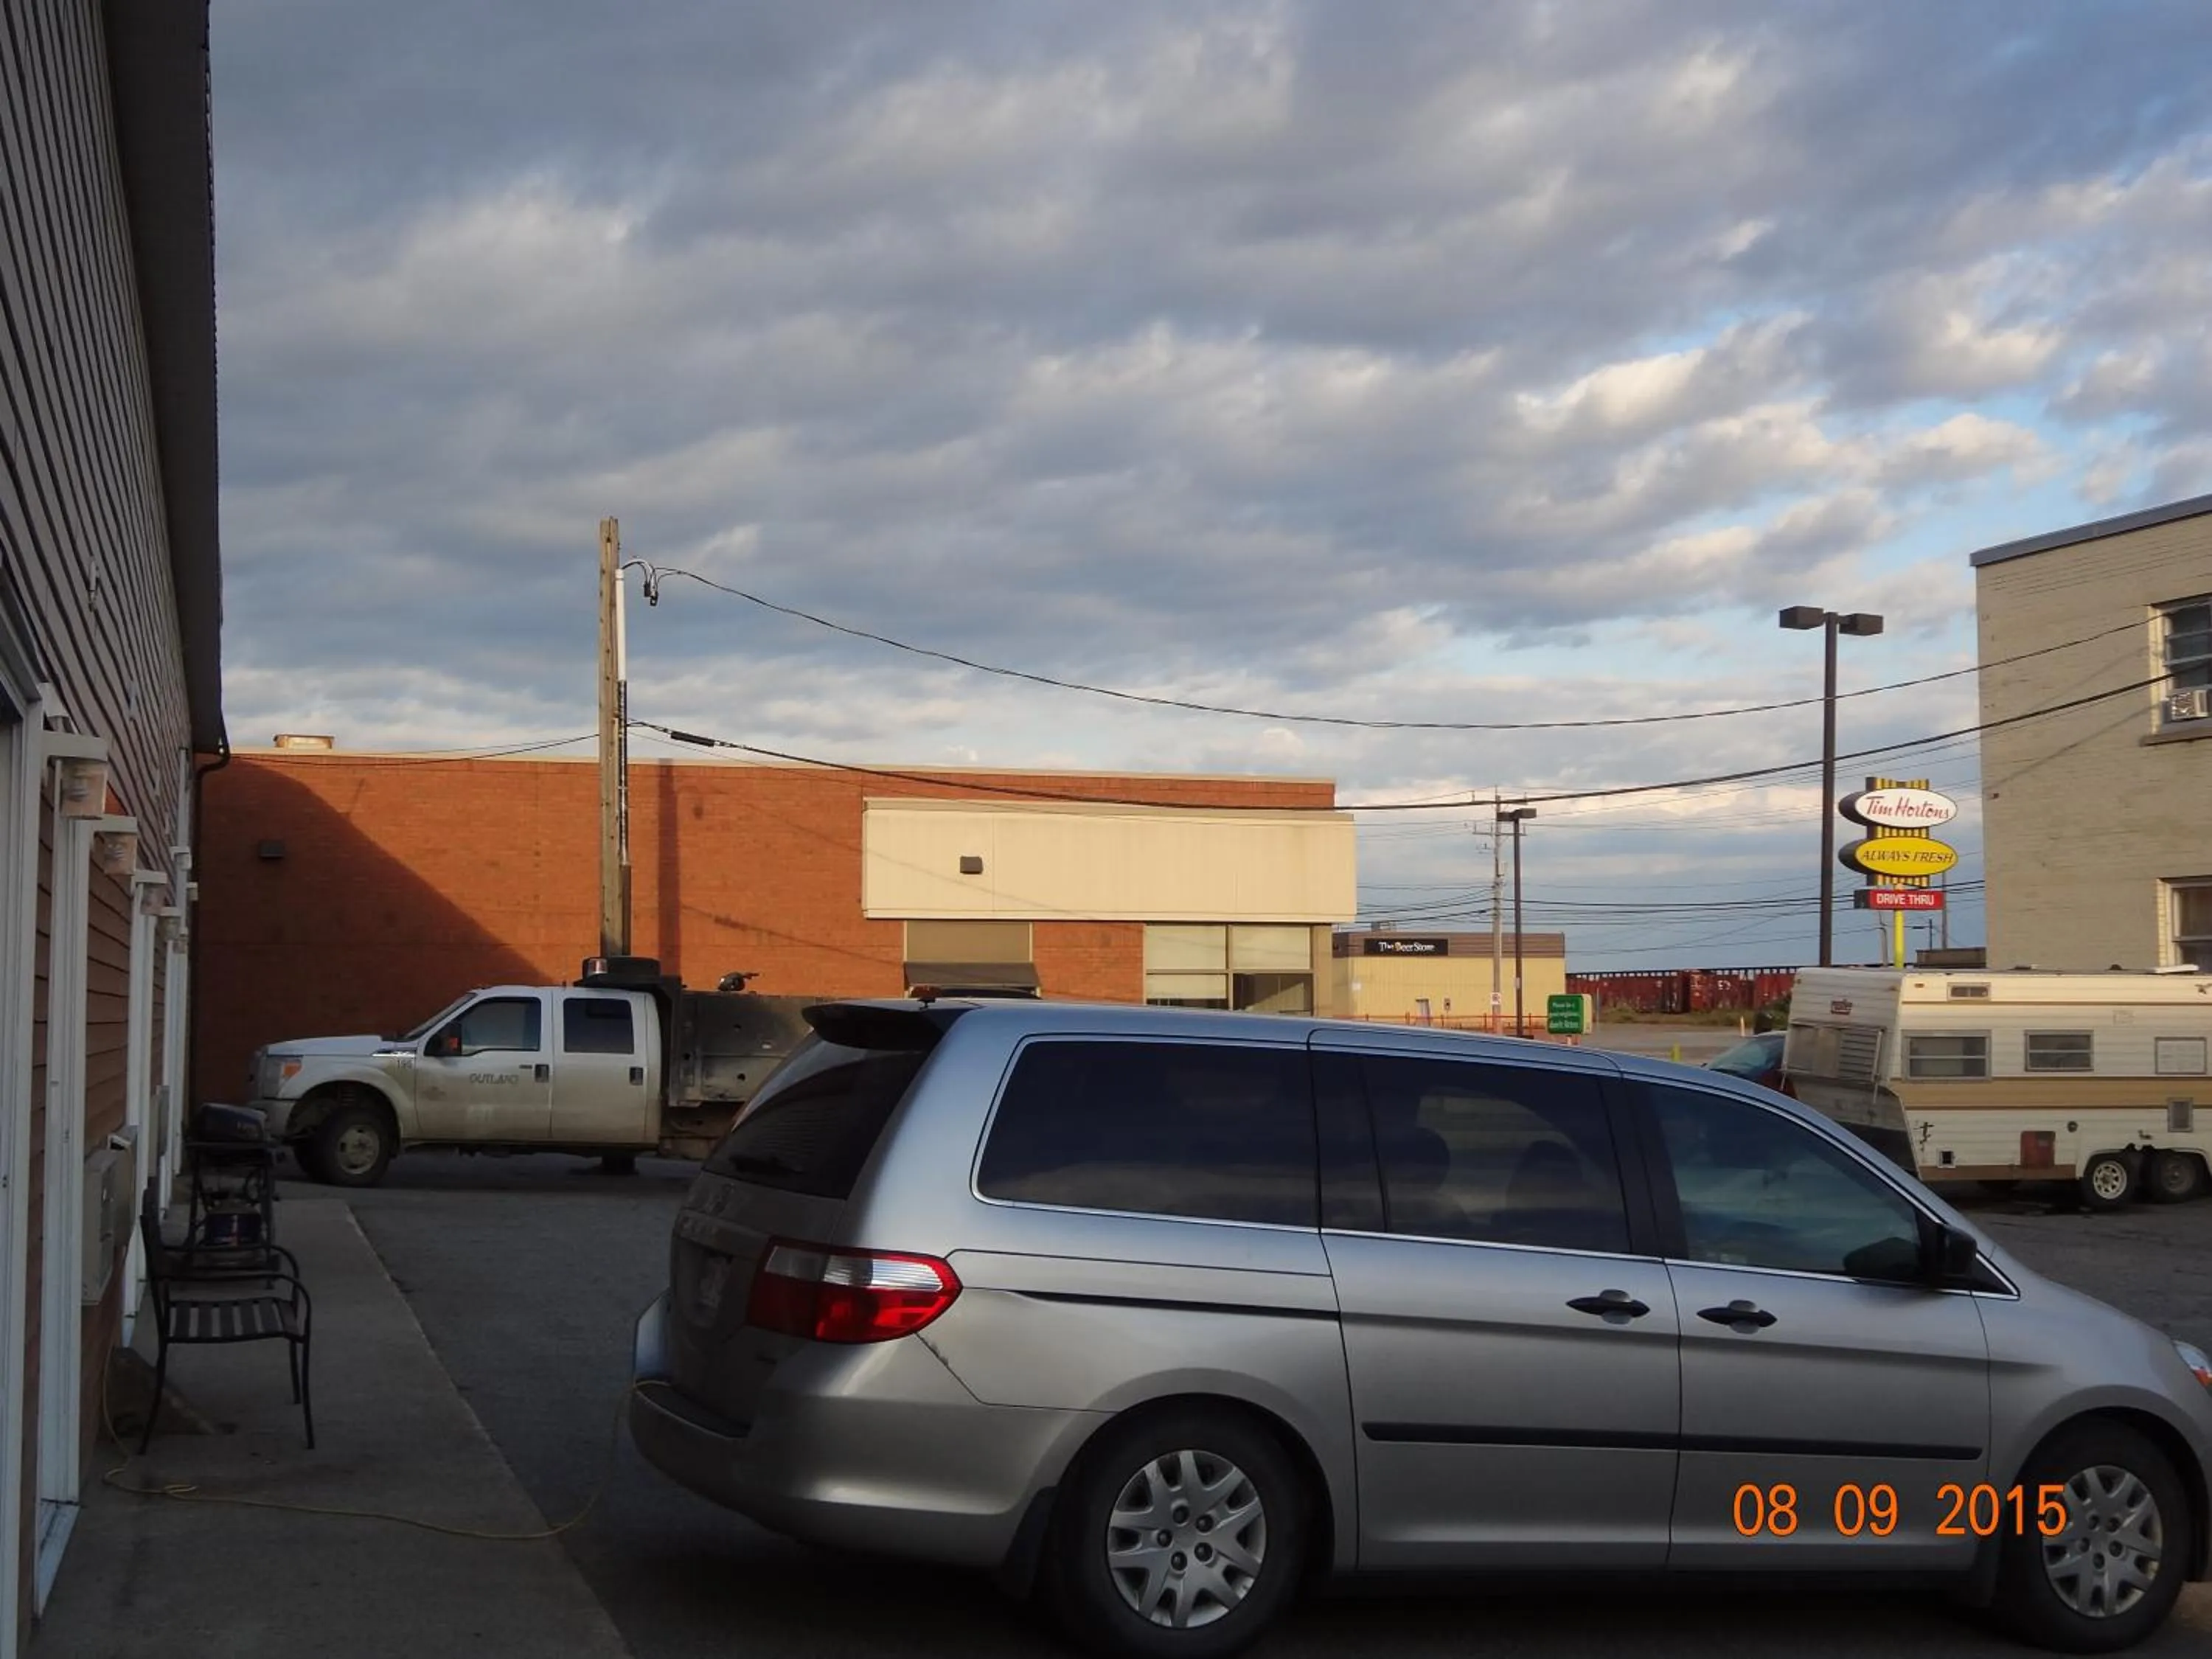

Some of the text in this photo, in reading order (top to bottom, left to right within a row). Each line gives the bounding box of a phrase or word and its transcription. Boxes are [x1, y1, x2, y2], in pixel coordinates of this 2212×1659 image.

[1866, 796, 1950, 819] Tim Hortons
[1863, 851, 1954, 863] ALWAYS FRESH
[1877, 894, 1935, 906] DRIVE THRU
[1378, 942, 1436, 952] The Beer Store
